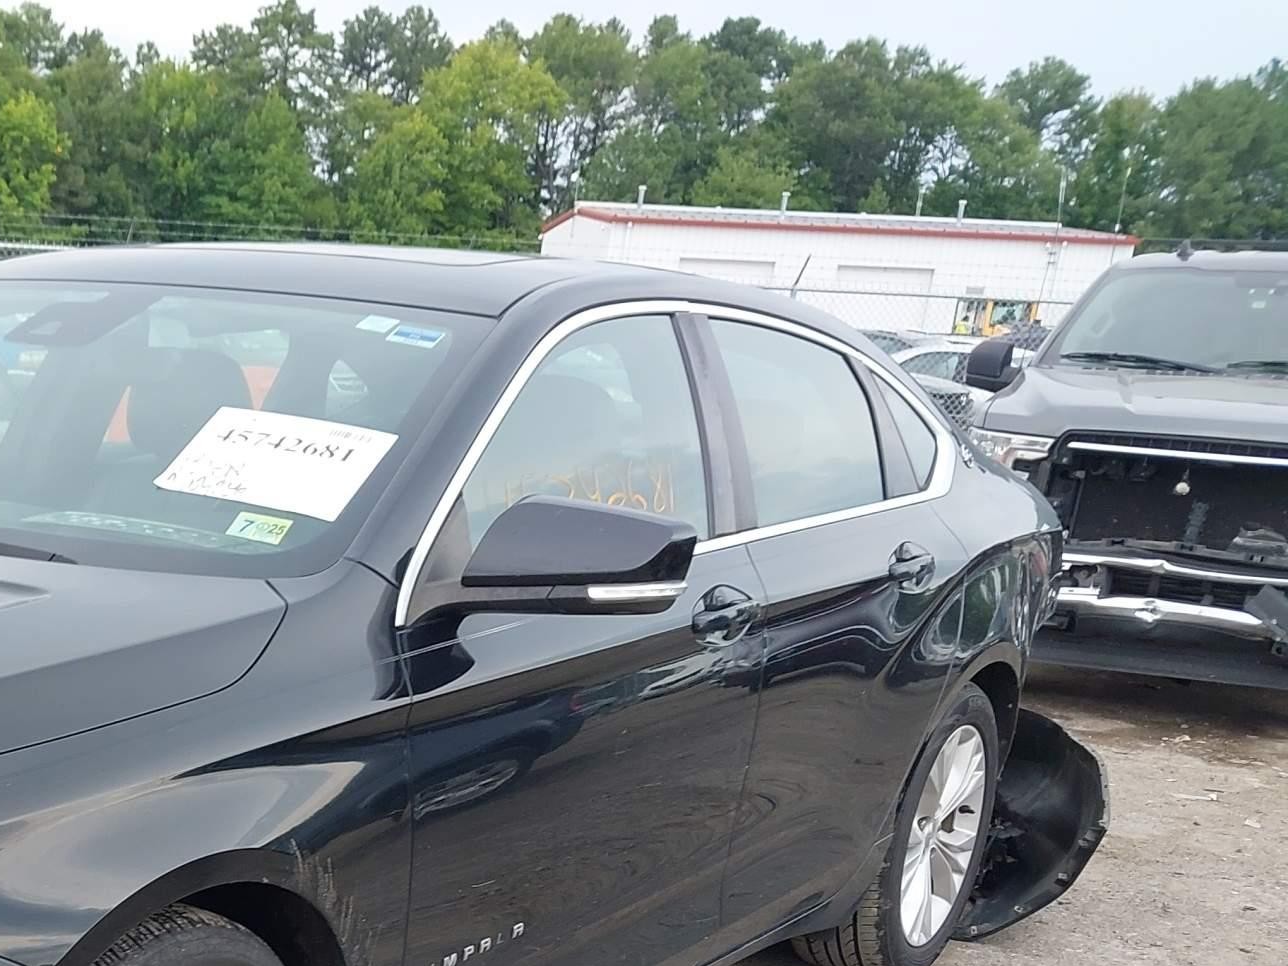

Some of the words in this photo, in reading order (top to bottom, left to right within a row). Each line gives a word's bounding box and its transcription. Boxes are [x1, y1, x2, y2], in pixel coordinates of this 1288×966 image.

[217, 429, 355, 462] 45742681
[240, 519, 254, 533] 7
[268, 524, 287, 535] 25
